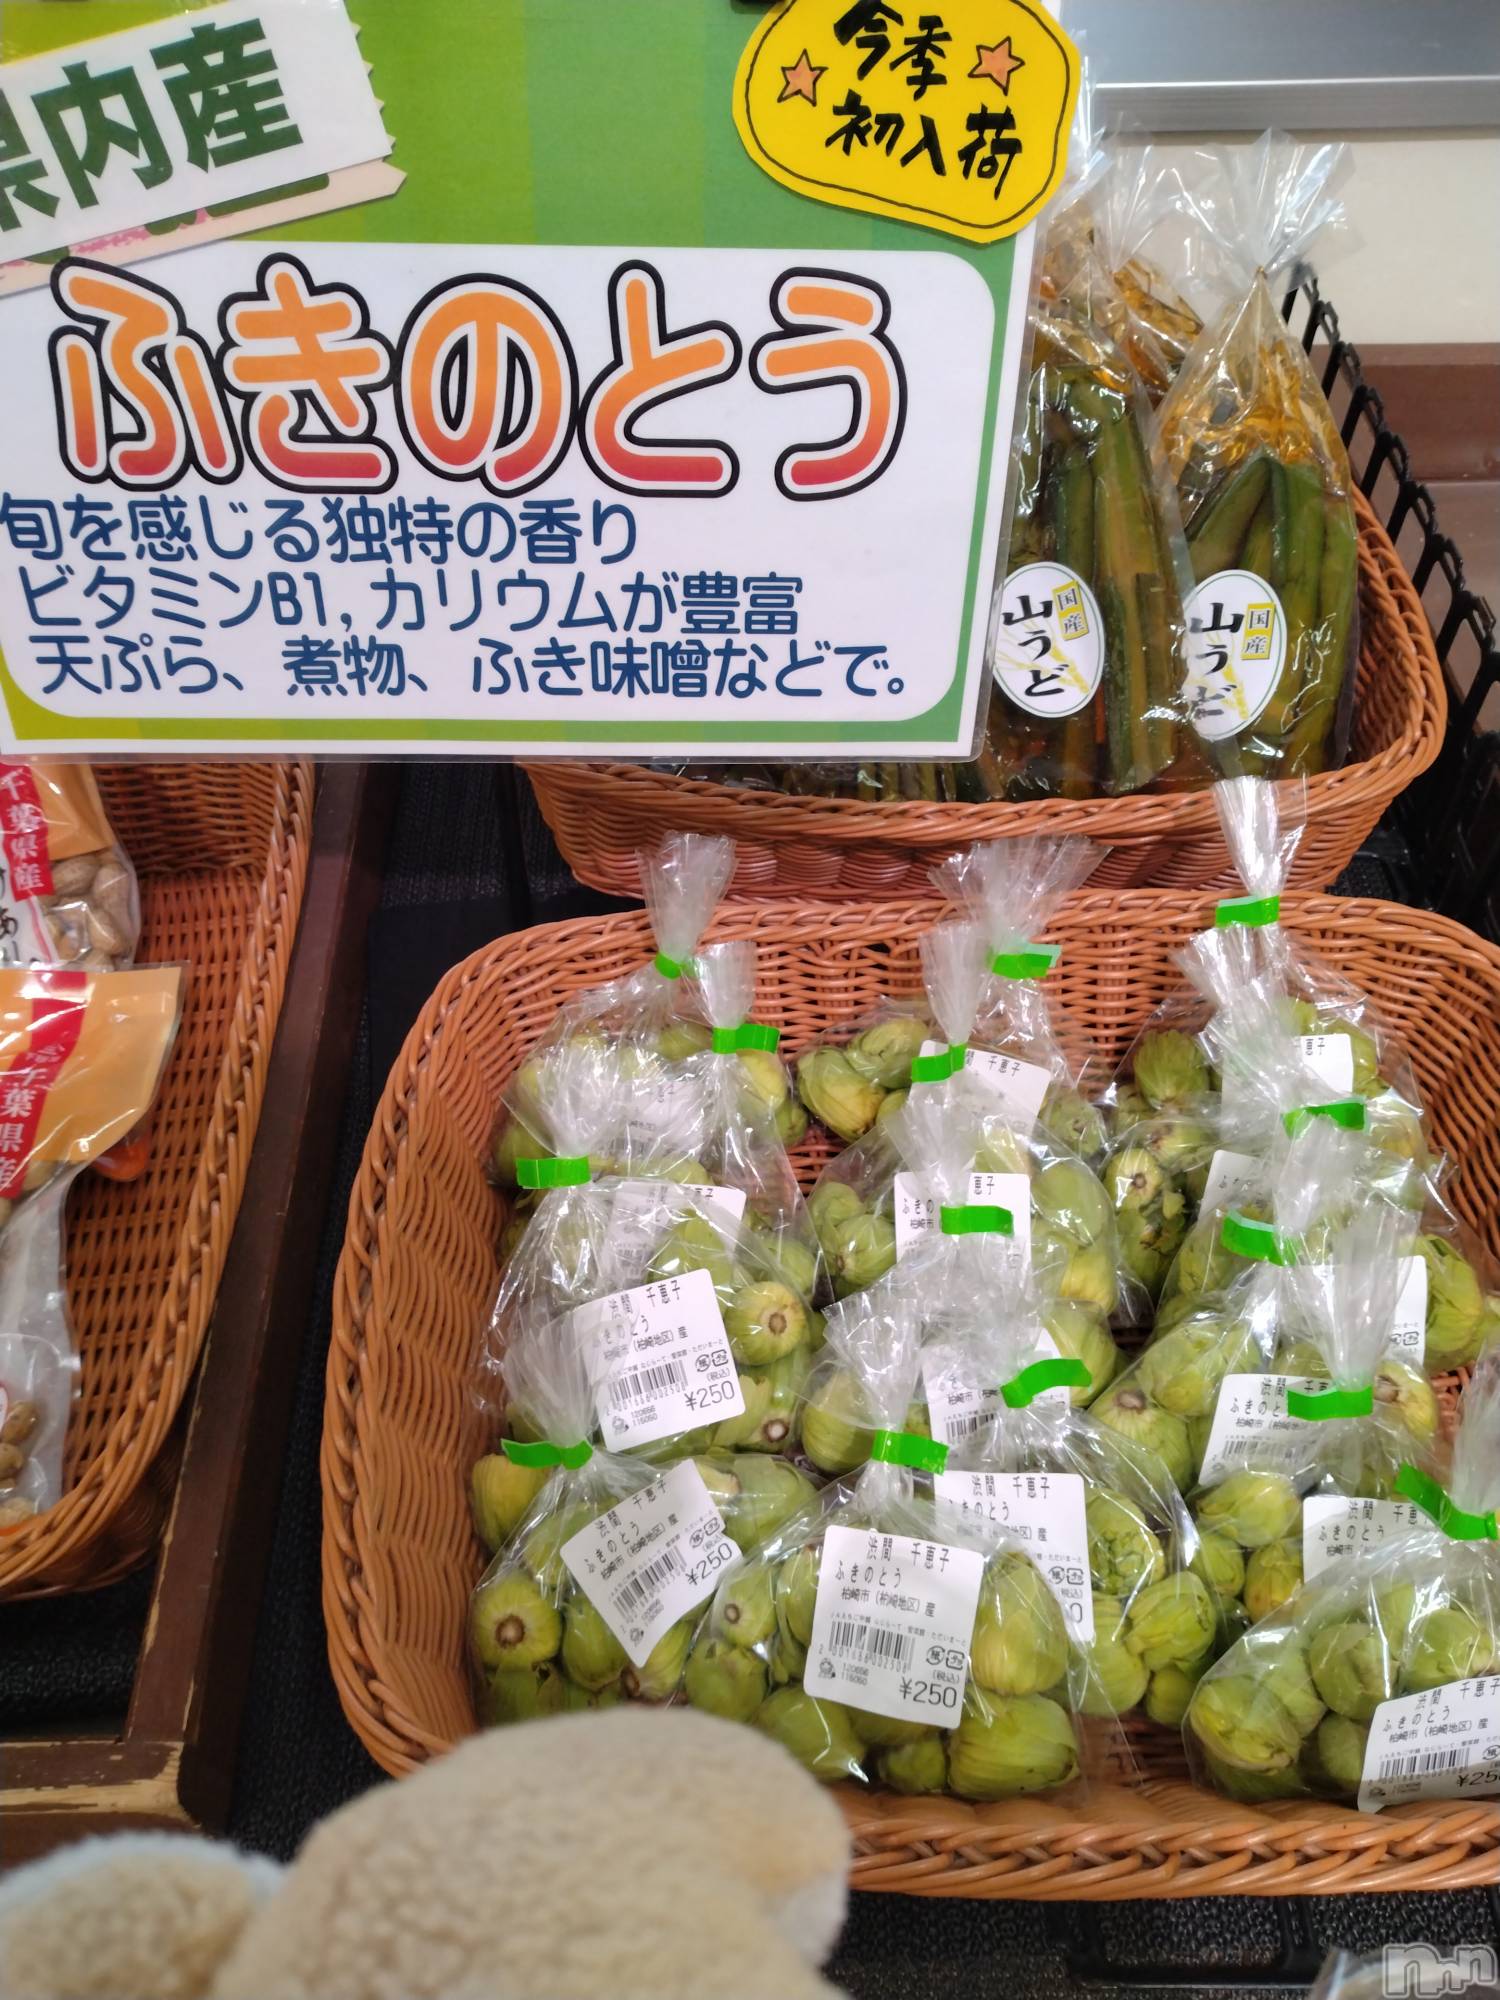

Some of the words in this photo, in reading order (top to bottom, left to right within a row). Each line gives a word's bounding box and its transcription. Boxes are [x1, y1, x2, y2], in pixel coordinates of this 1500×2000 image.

[833, 0, 952, 101] 今季
[825, 89, 1022, 200] 初入荷
[48, 253, 908, 498] ふきのとう
[0, 491, 637, 564] 旬を感じる独特の香り
[1057, 587, 1085, 635] 国産
[1244, 609, 1270, 655] 国産
[1002, 594, 1070, 697] 山うど
[1190, 602, 1245, 720] 山うど
[1, 768, 44, 890] 千葉県産
[684, 1380, 736, 1412] ¥250
[686, 1542, 733, 1586] ¥250
[835, 1559, 903, 1589] ふきのとう
[899, 1676, 958, 1709] ¥250
[1456, 1770, 1500, 1788] ¥25
